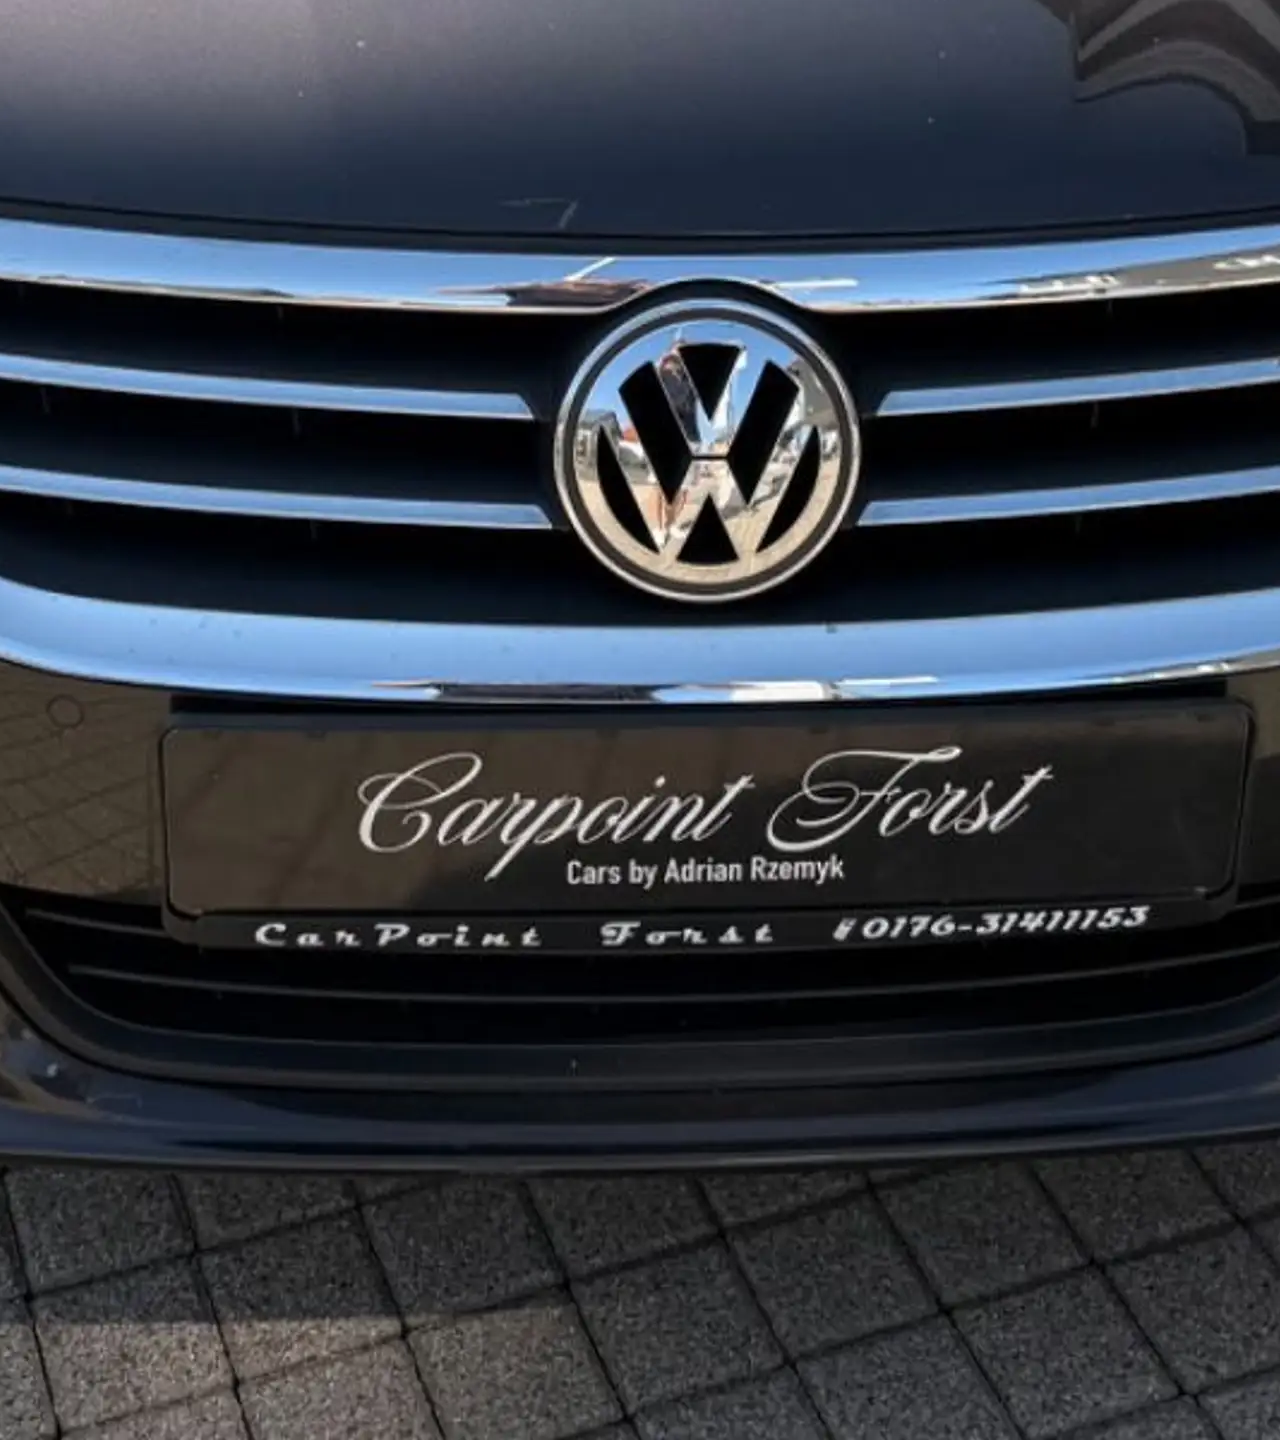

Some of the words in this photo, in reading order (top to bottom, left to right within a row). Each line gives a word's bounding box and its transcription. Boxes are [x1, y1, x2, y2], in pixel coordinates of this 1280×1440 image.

[358, 752, 755, 883] Carpoint
[766, 745, 1054, 853] Forst
[567, 860, 622, 886] Cars
[629, 859, 658, 890] by
[664, 857, 744, 884] Adrian
[750, 854, 845, 885] Rzemyk
[254, 921, 543, 948] CarPoint
[600, 920, 775, 946] Forst
[861, 905, 1151, 941] 0176-31411153
